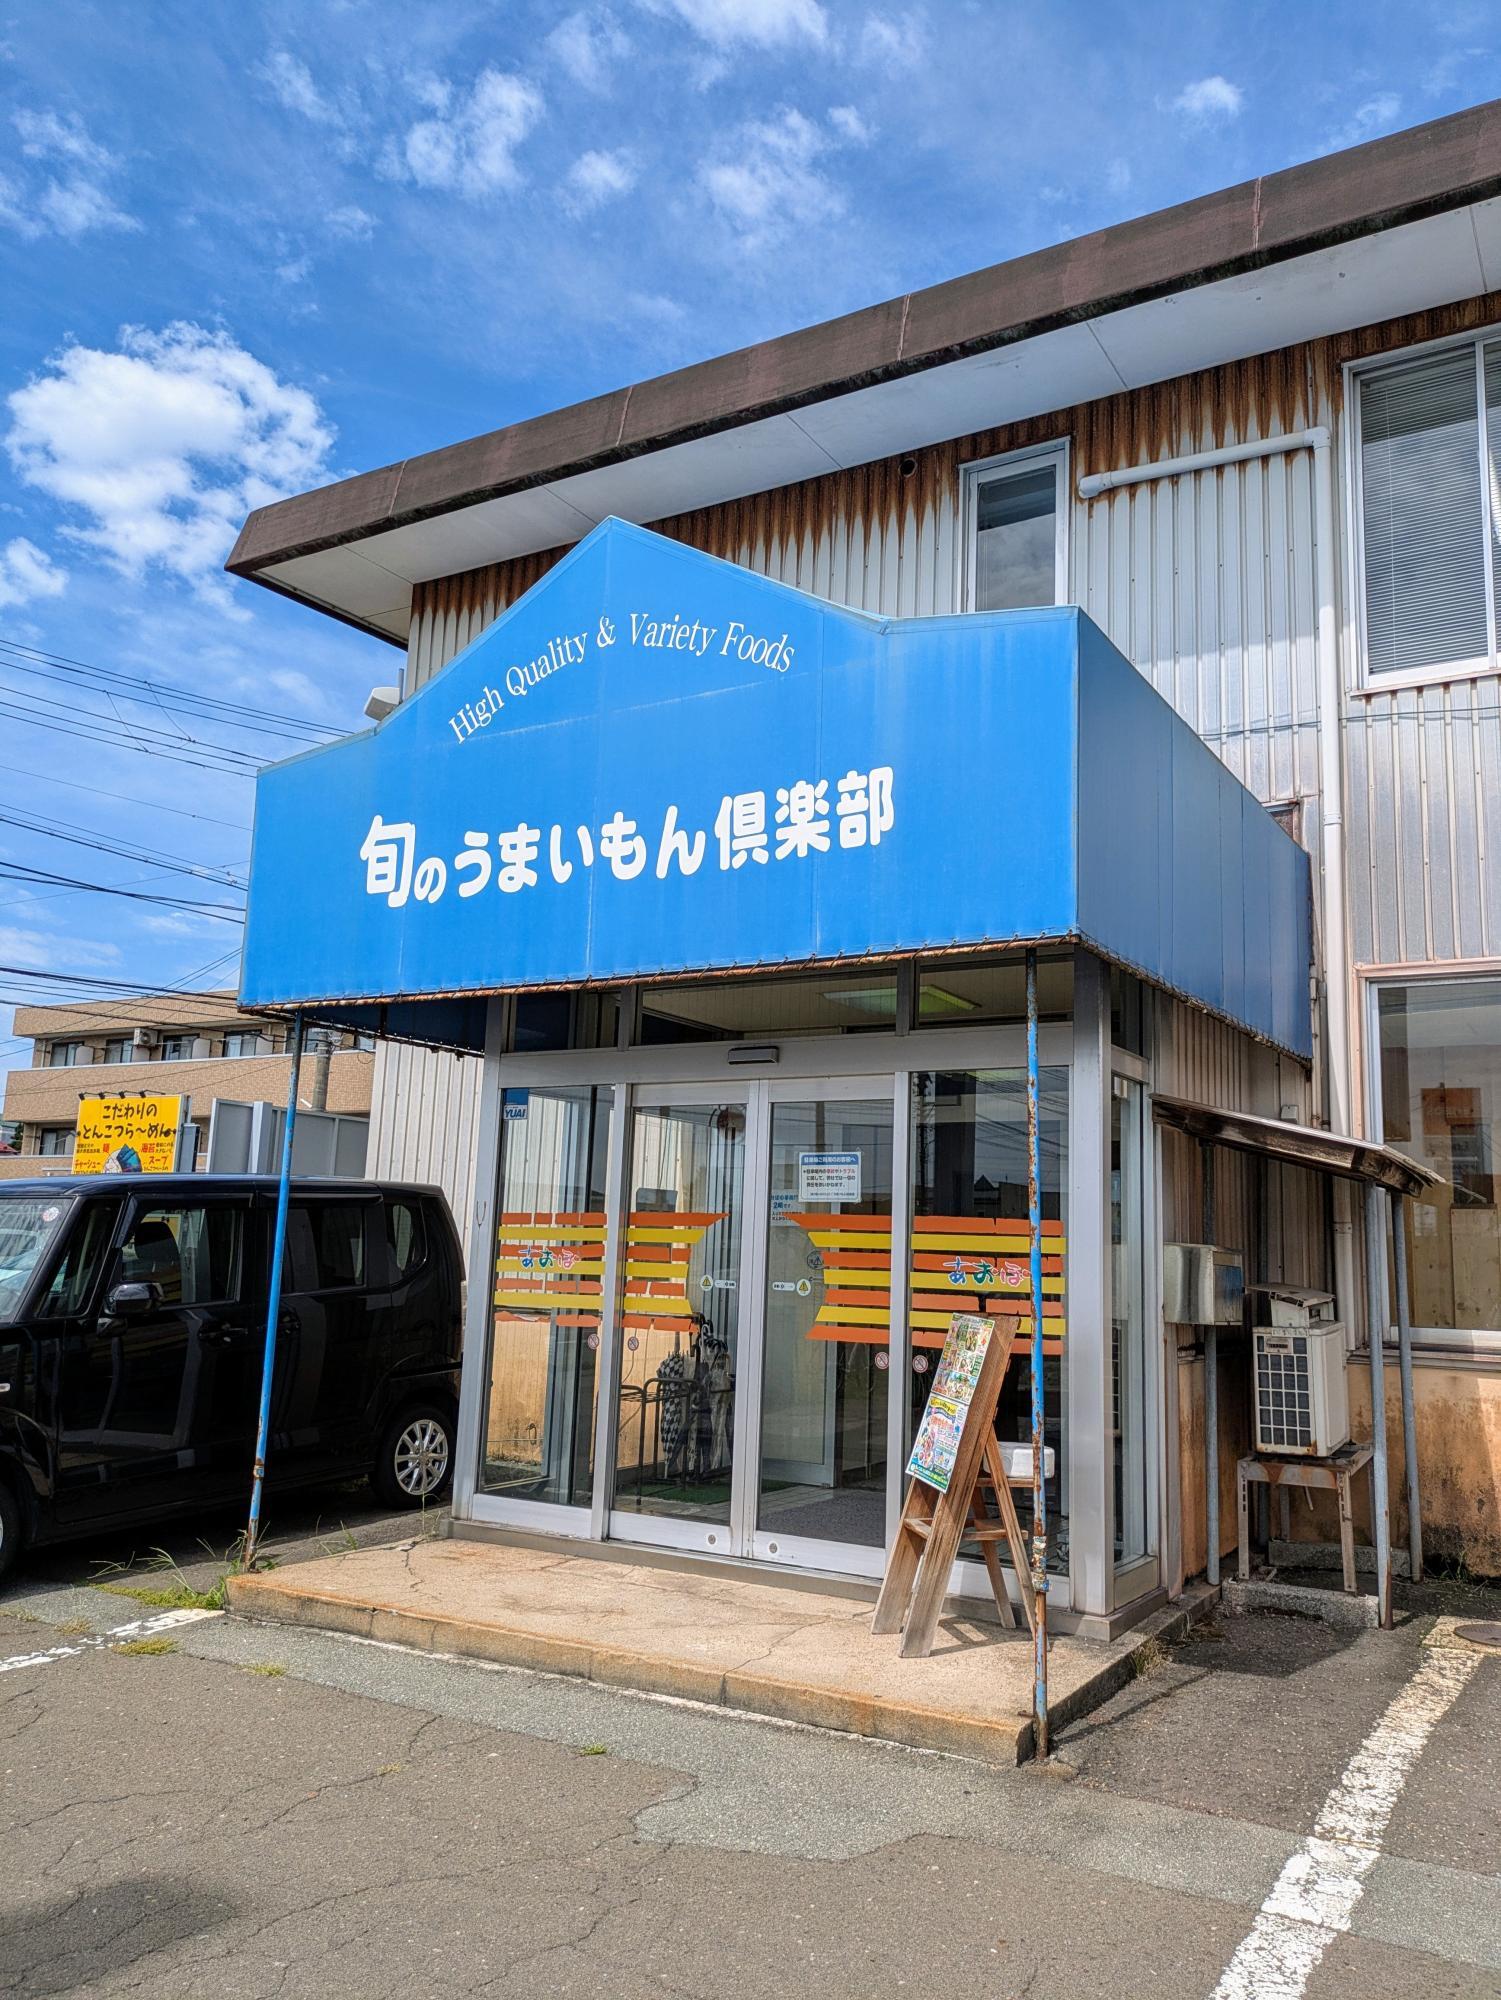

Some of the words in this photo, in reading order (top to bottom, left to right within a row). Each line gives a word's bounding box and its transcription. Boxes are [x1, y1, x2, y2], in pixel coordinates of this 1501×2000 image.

[448, 686, 505, 744] High
[505, 630, 588, 697] Quality
[596, 616, 616, 648] &
[628, 612, 718, 658] Variety
[719, 621, 796, 673] Foods
[359, 766, 896, 908] 旬のうまいもん倶楽部
[102, 1102, 157, 1120] こだわりの
